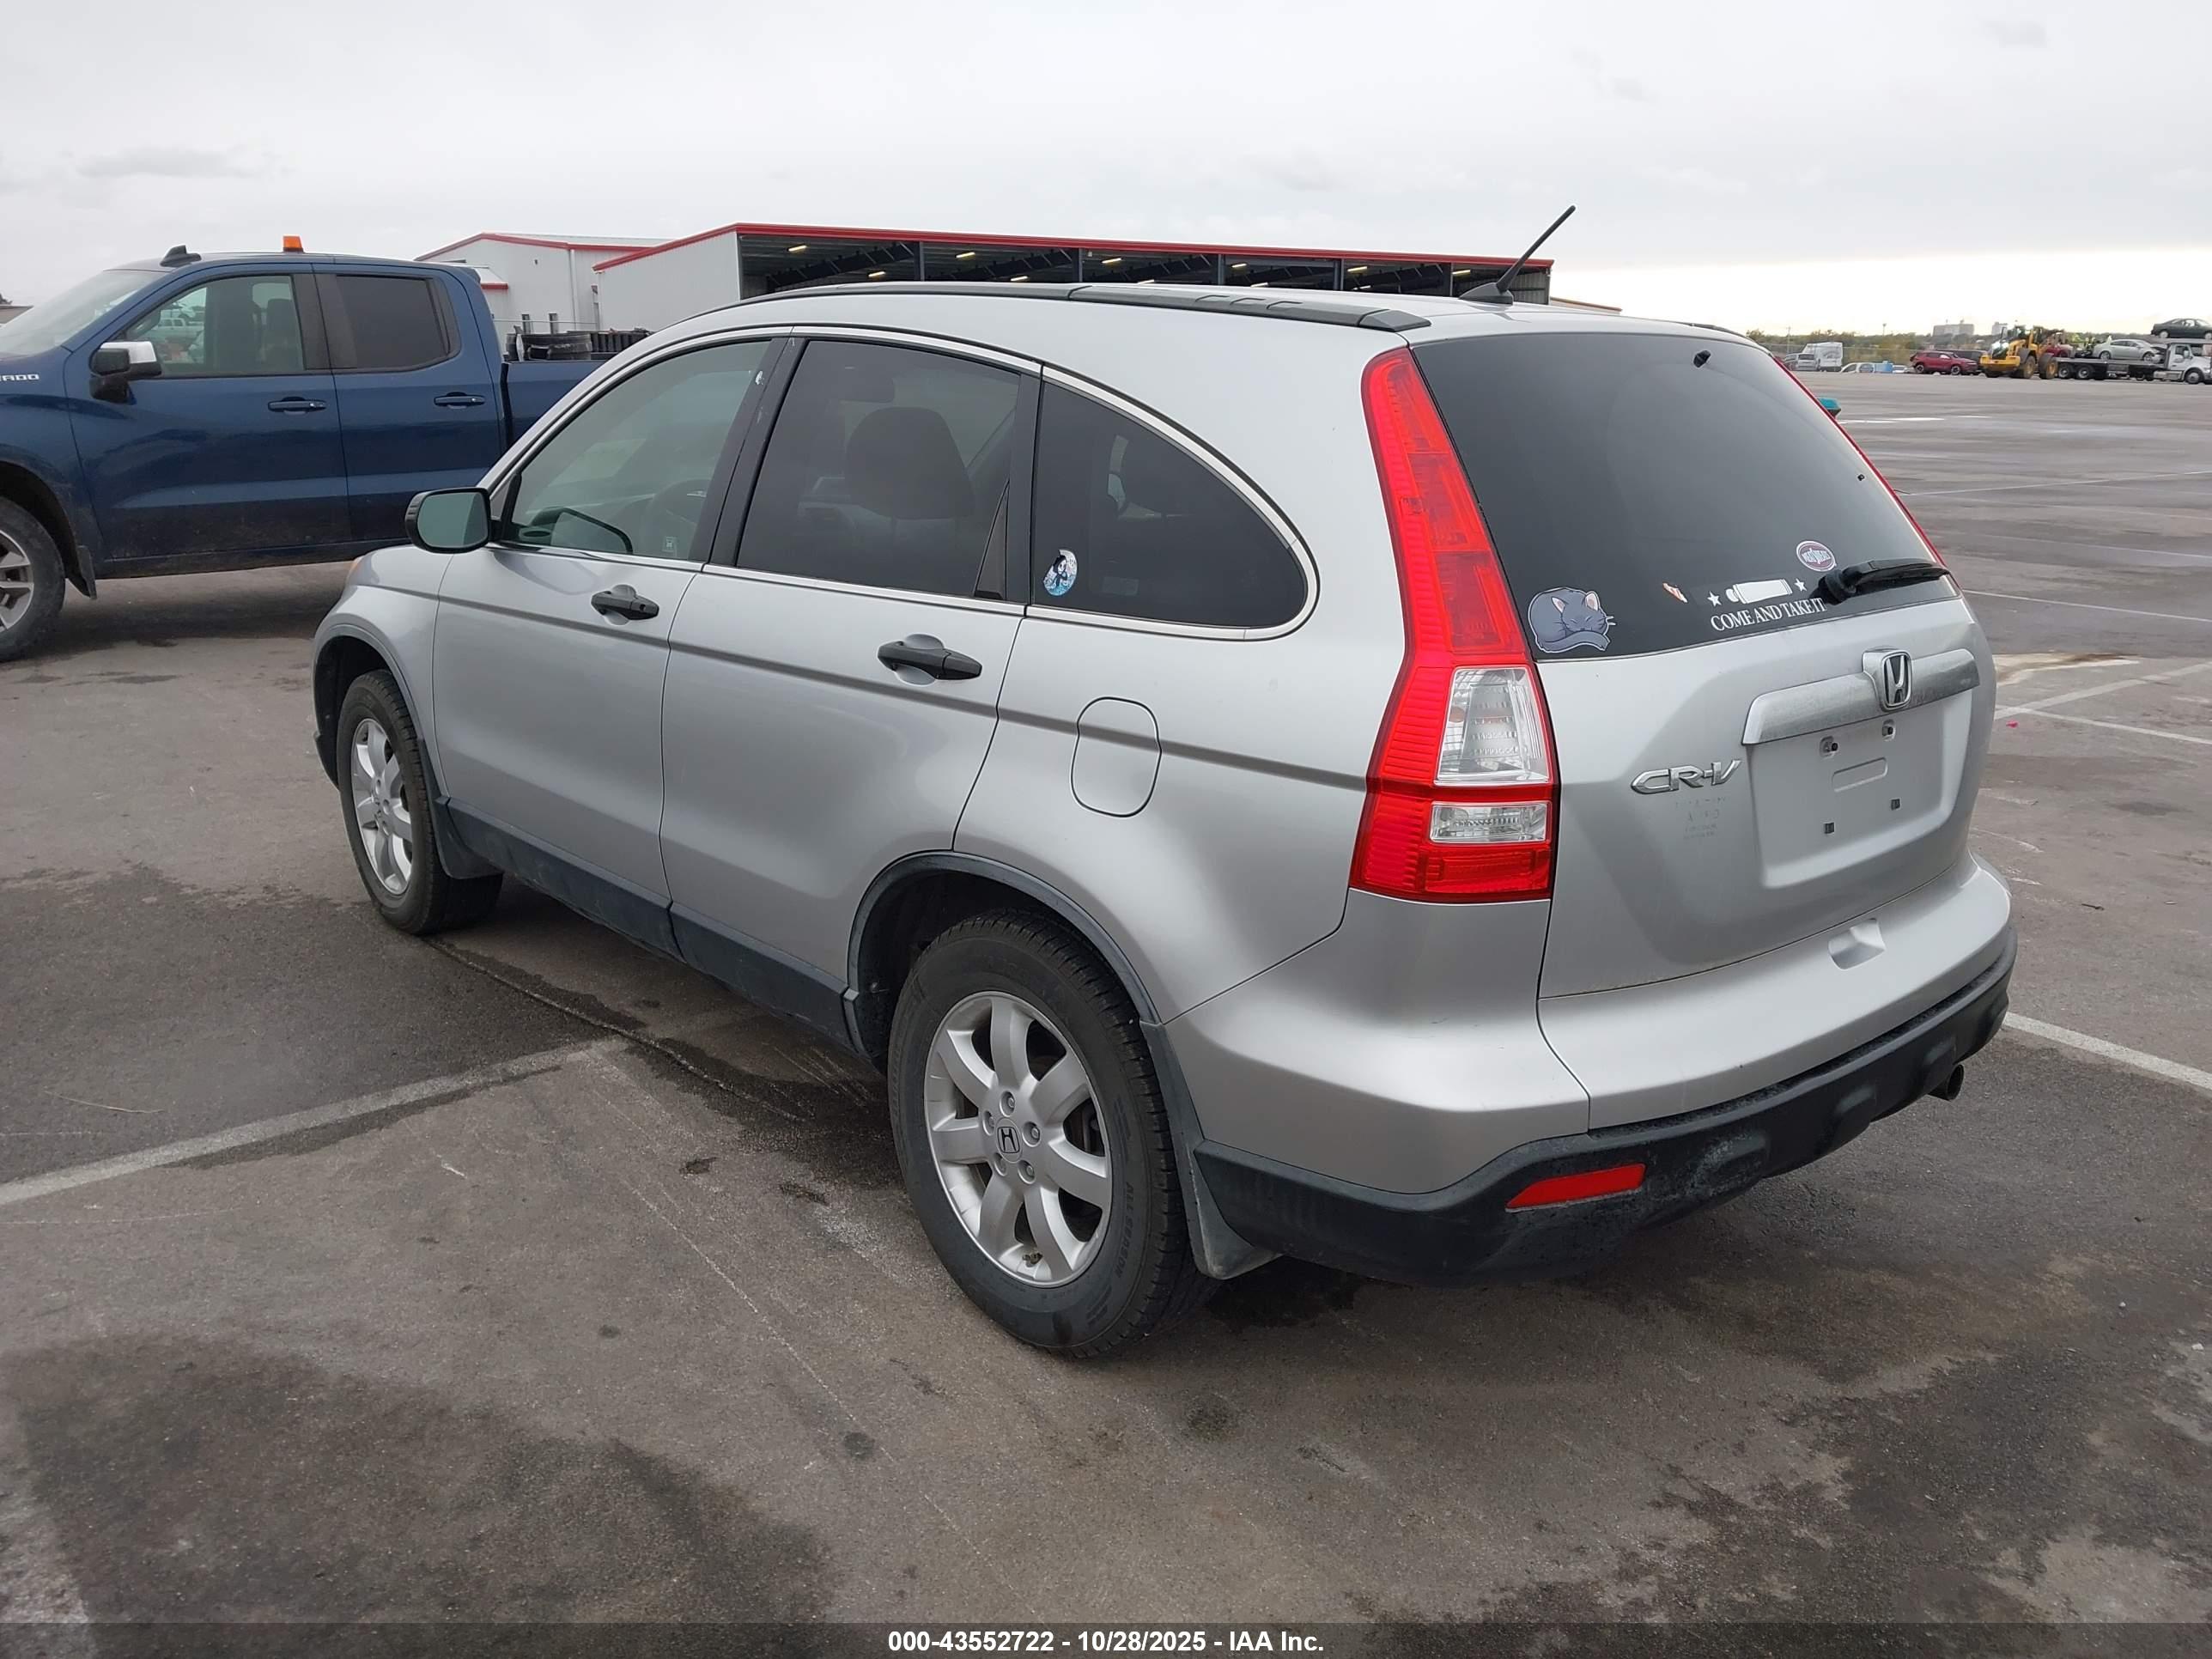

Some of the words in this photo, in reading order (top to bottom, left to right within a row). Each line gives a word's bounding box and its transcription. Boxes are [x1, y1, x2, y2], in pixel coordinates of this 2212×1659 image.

[1711, 610, 1754, 631] COME
[1753, 605, 1783, 623] AND
[1779, 599, 1814, 617] TAKE
[1809, 598, 1828, 612] IT
[1631, 759, 1741, 795] CR-V
